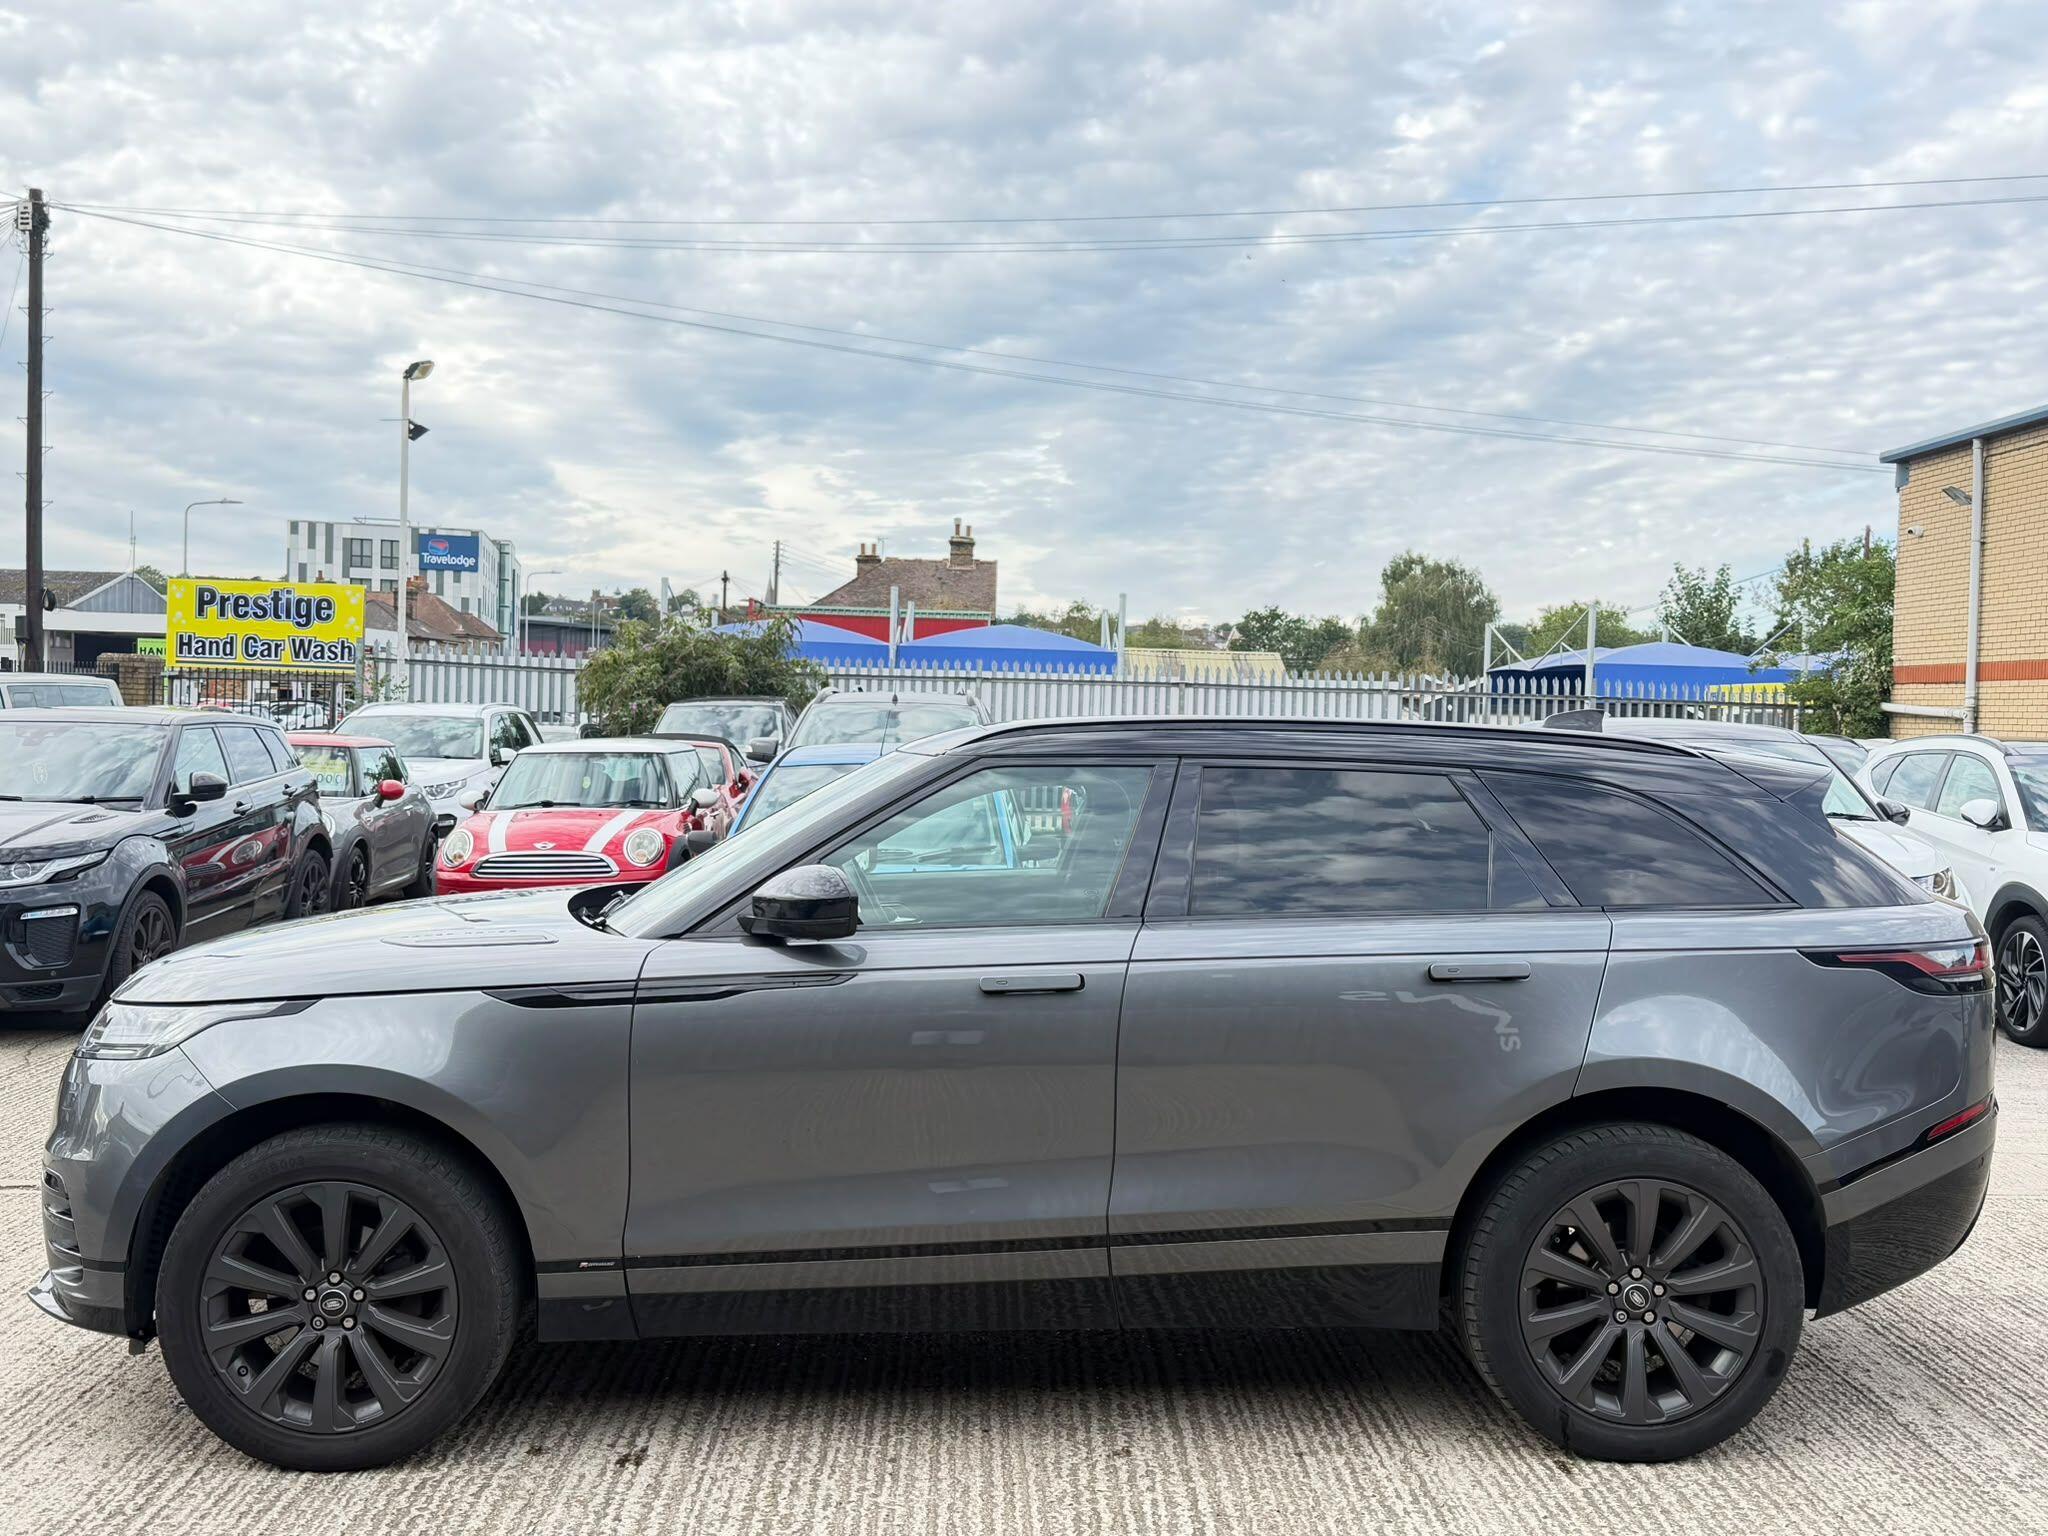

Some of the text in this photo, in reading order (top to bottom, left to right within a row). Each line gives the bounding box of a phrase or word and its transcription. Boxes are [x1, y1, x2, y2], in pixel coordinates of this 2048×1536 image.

[421, 552, 476, 568] Travelodge
[195, 585, 336, 630] Prestige
[139, 646, 167, 656] HAN
[176, 632, 356, 665] Hand Car Wash
